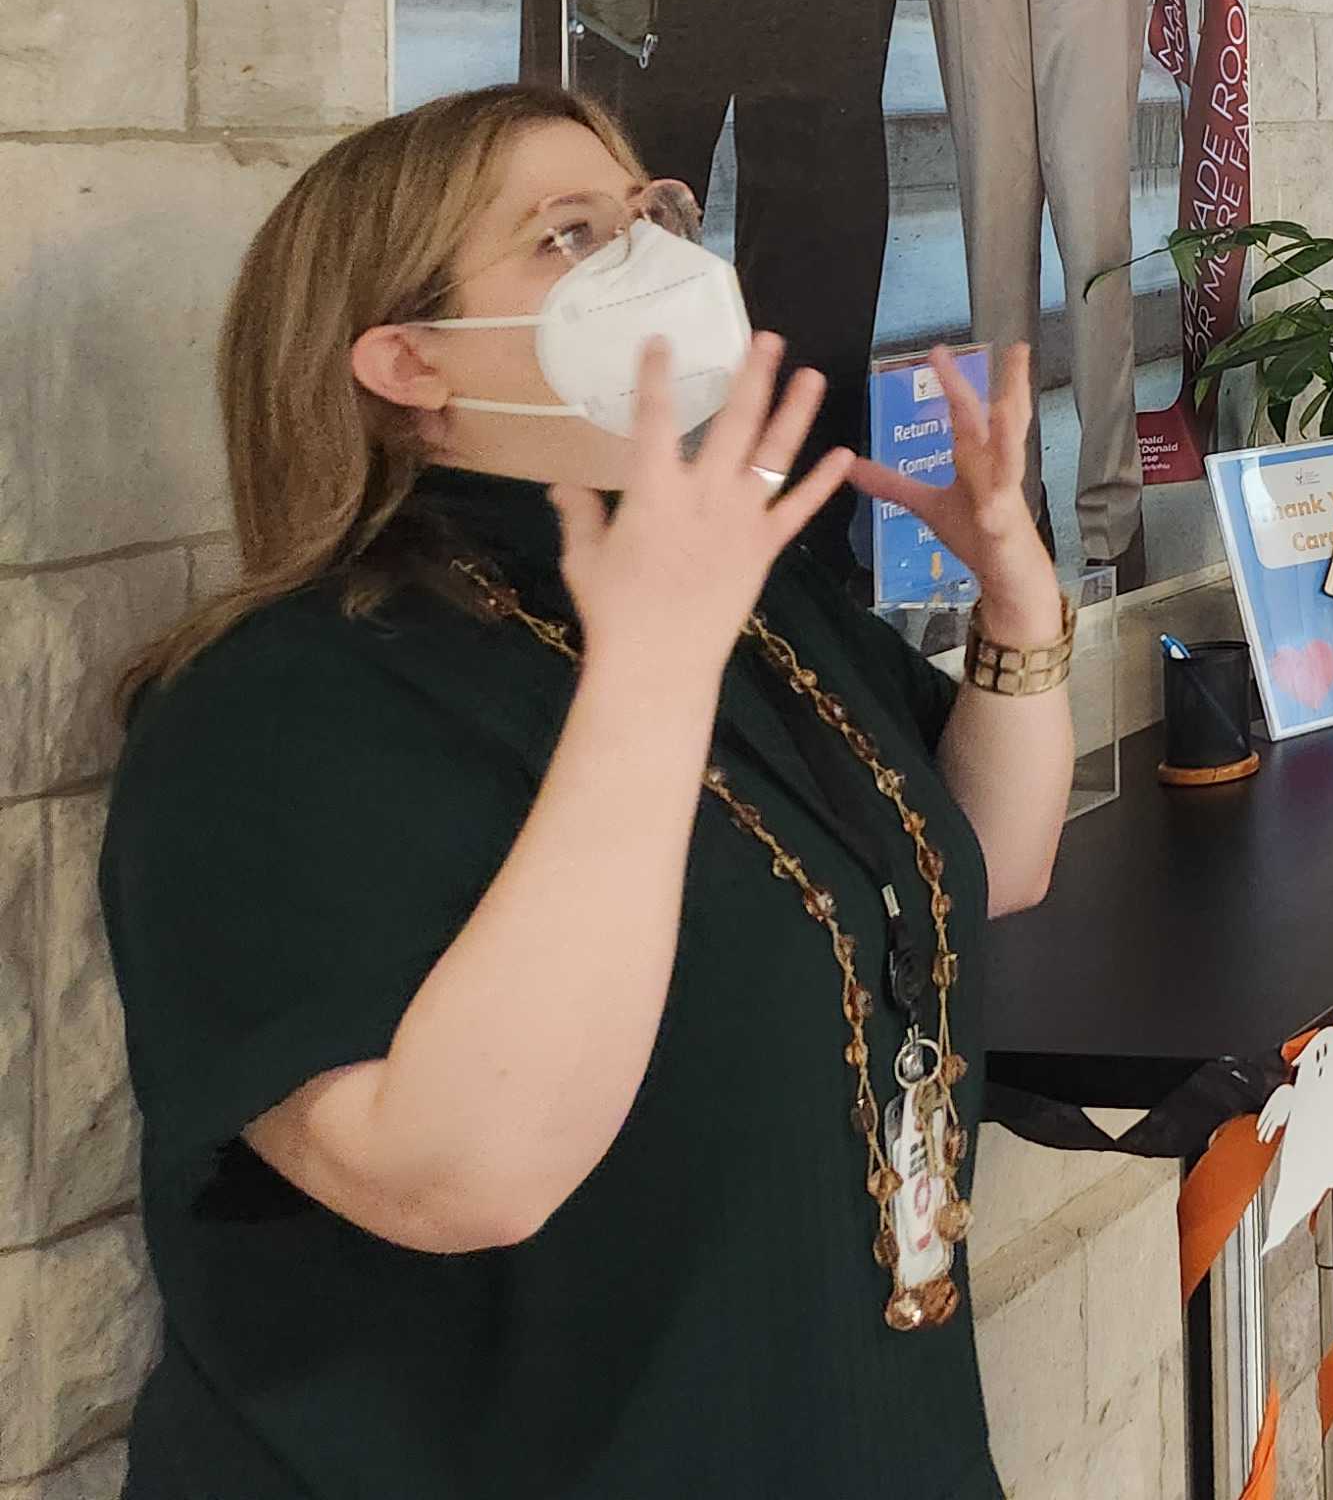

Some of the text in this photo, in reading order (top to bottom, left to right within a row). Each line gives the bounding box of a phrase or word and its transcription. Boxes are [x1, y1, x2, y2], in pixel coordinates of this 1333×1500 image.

[1190, 124, 1229, 276] ADE
[894, 420, 938, 443] Return
[1138, 443, 1179, 454] Donald
[898, 449, 953, 476] Complet
[1273, 493, 1327, 521] hank
